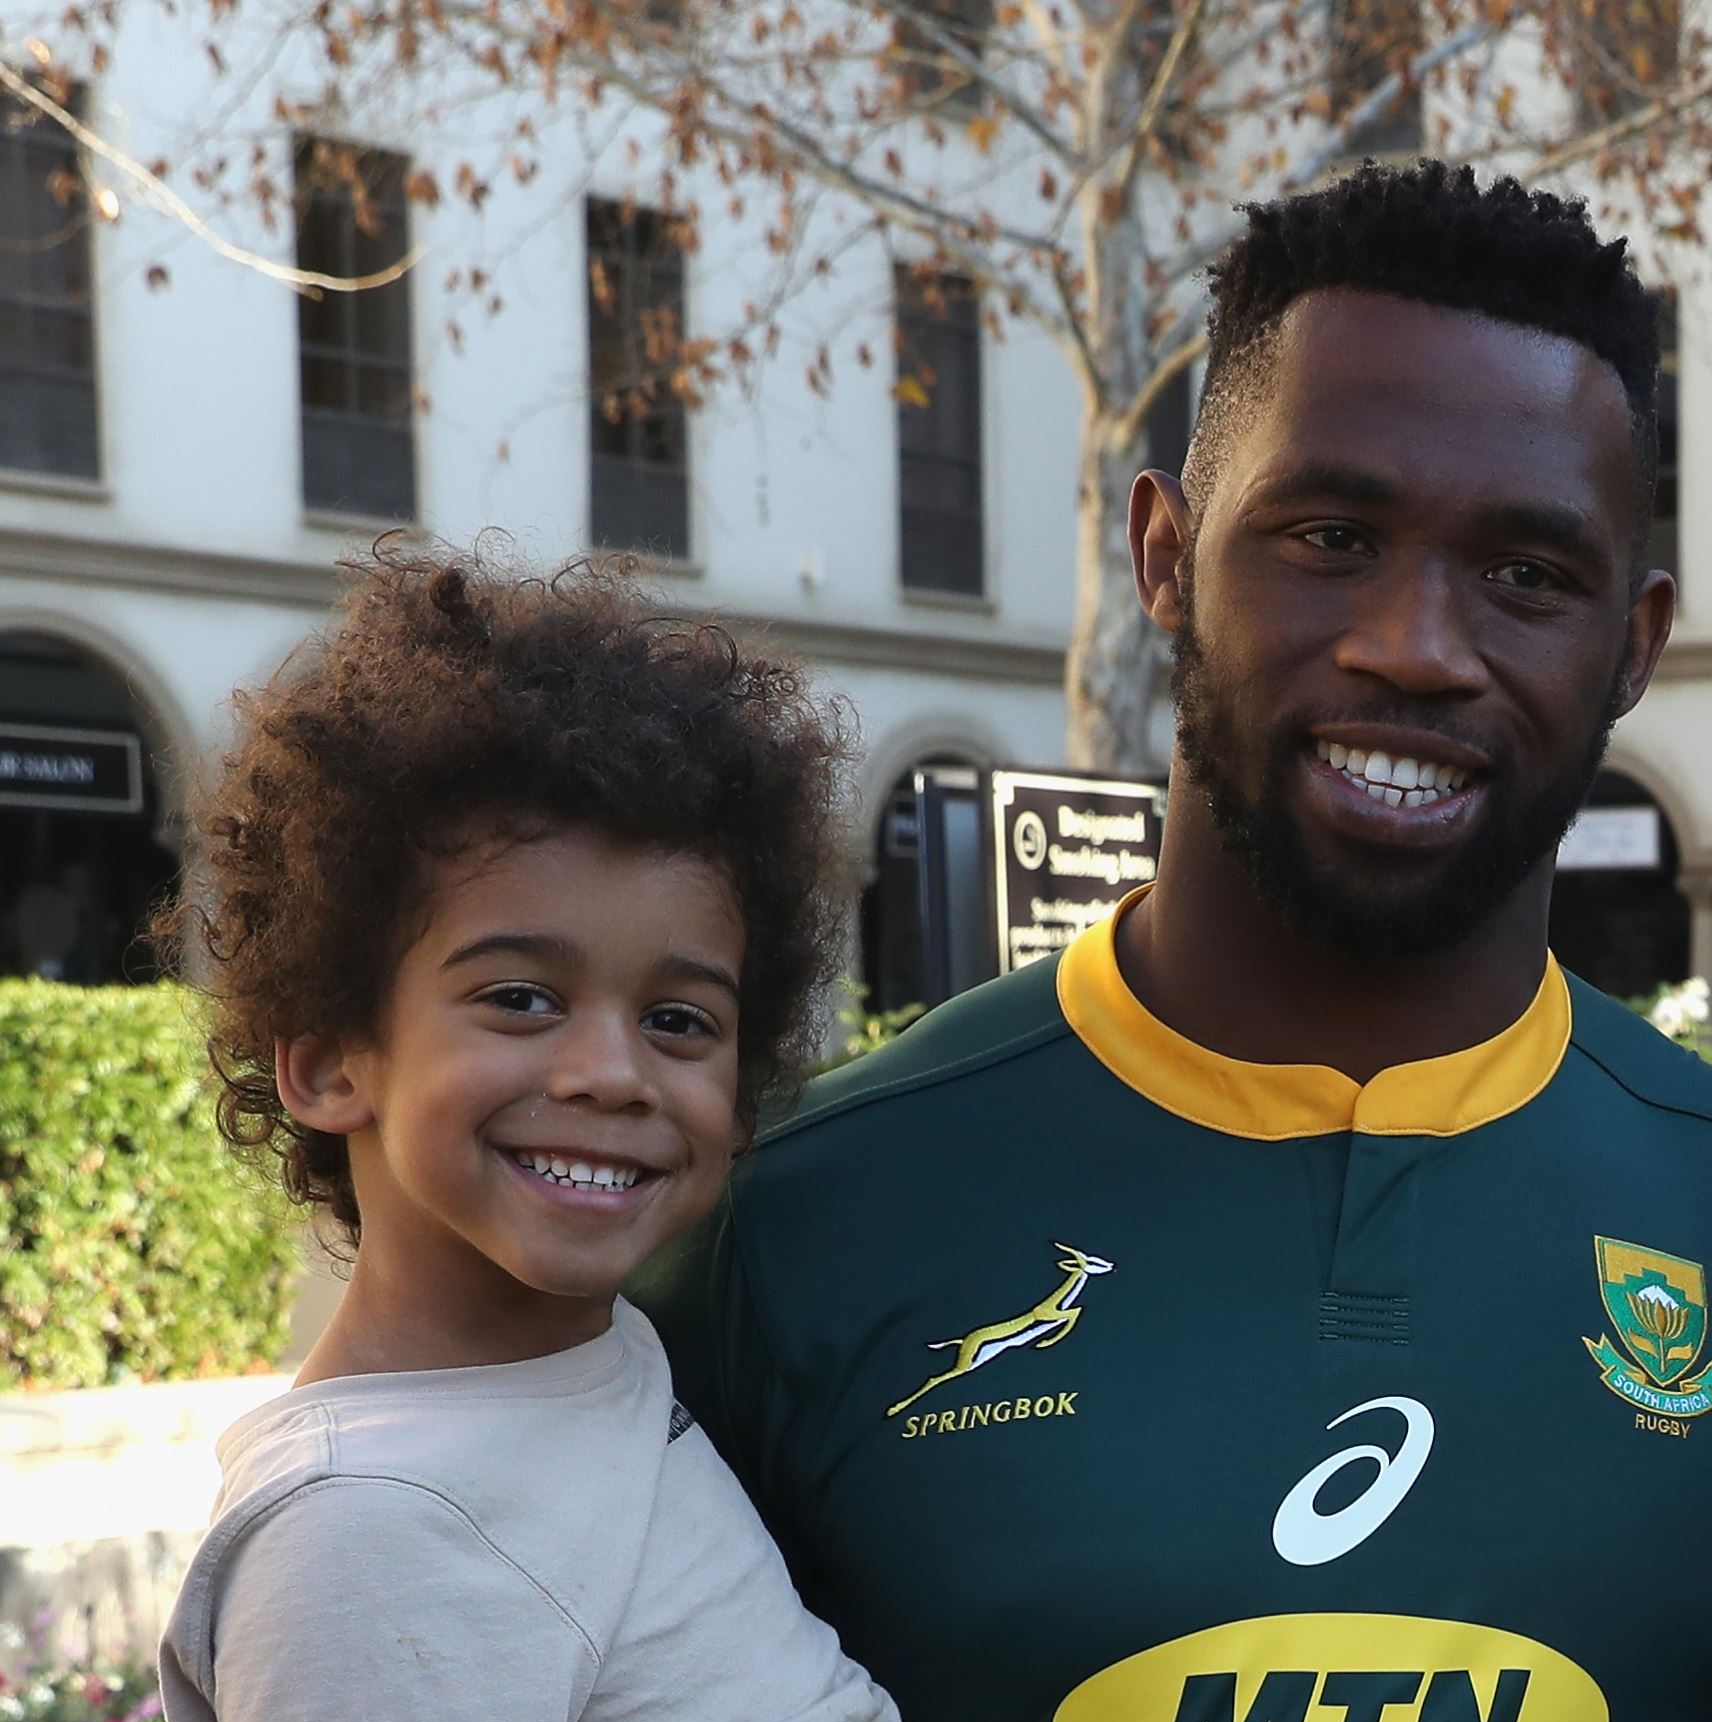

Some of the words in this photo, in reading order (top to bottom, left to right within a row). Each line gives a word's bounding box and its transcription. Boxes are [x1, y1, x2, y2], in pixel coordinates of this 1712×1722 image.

[1613, 1374, 1660, 1411] SOUTH
[1663, 1392, 1711, 1413] AFRICA
[901, 1392, 1079, 1439] SPRINGBOK
[1634, 1413, 1691, 1439] RUGBY
